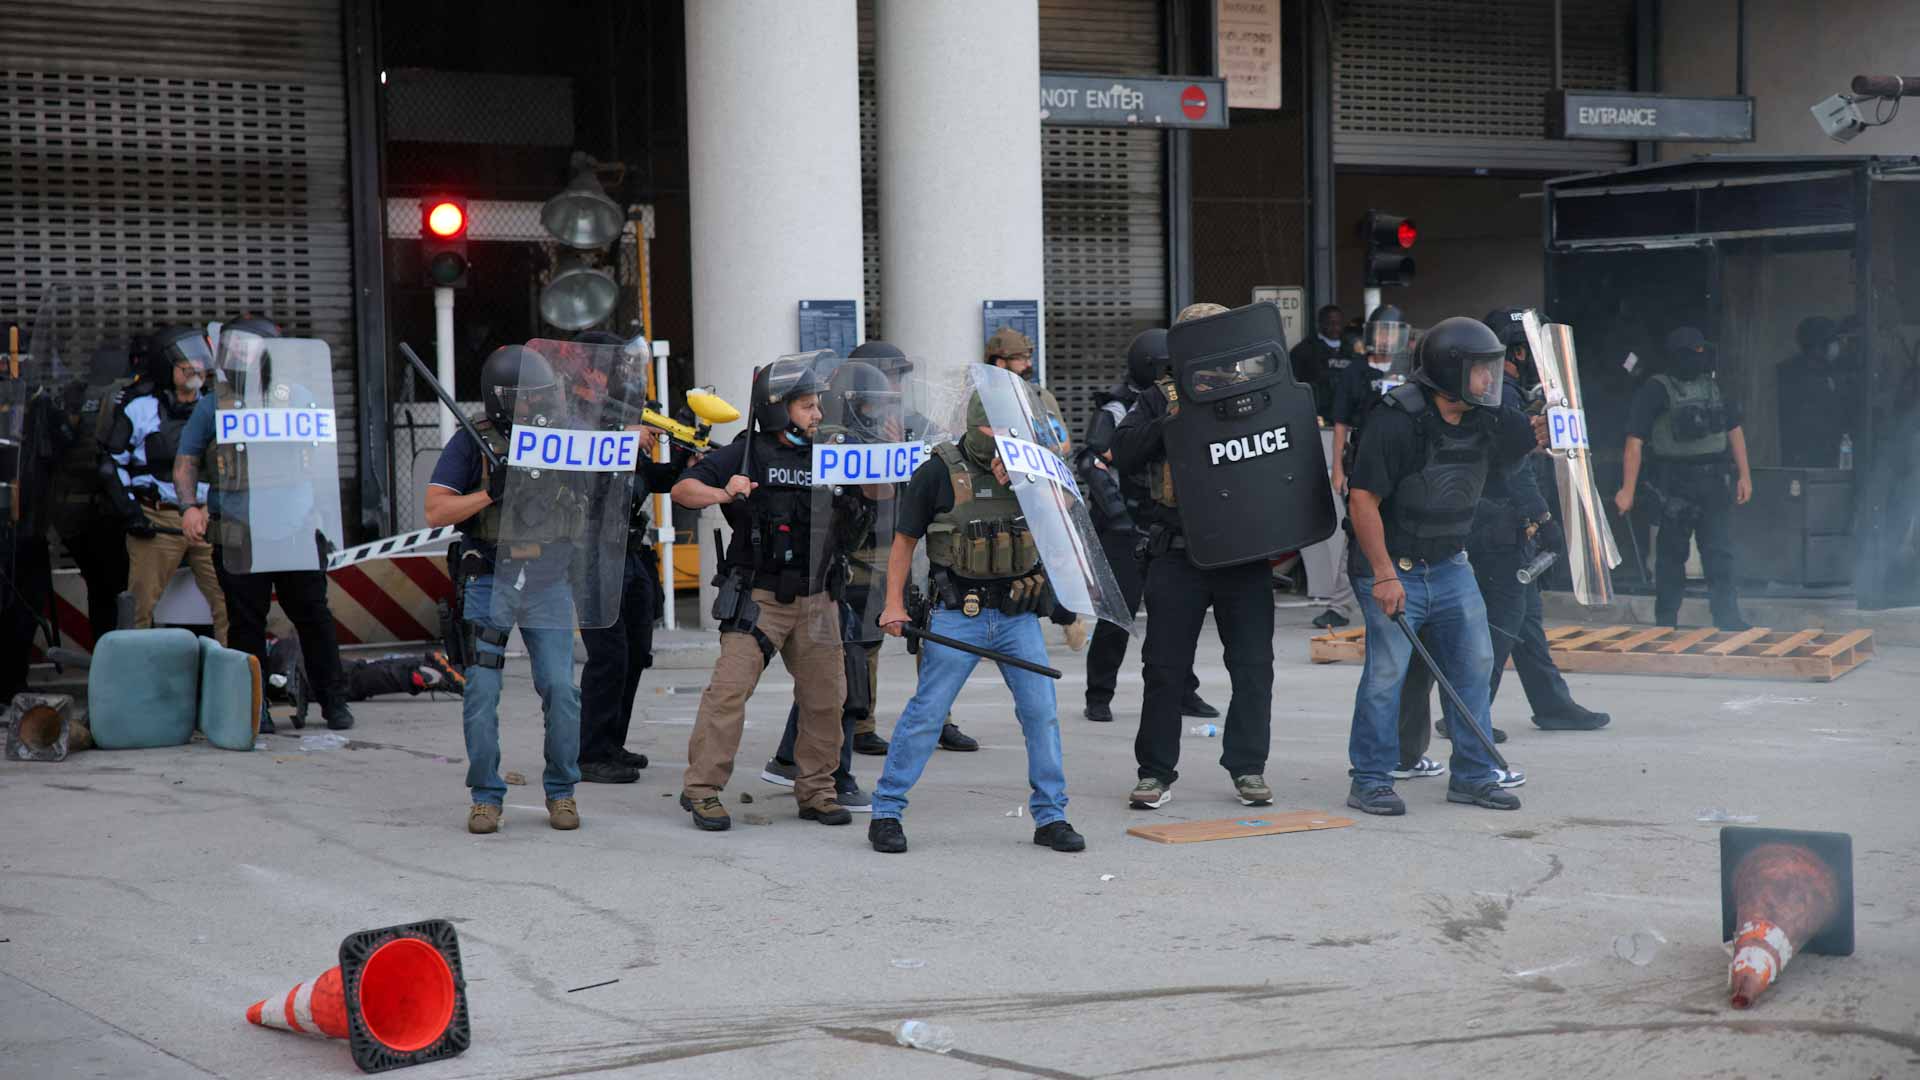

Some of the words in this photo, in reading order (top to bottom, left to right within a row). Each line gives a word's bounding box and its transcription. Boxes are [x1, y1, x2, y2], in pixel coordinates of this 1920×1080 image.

[1041, 88, 1078, 108] NOT
[1086, 89, 1144, 110] ENTER
[1579, 107, 1656, 126] ENTRANCE
[222, 411, 331, 439] POLICE
[1553, 414, 1587, 444] POL
[516, 431, 634, 466] POLICE
[1209, 427, 1289, 465] POLICE
[768, 467, 812, 486] POLICE
[820, 446, 921, 480] POLICE
